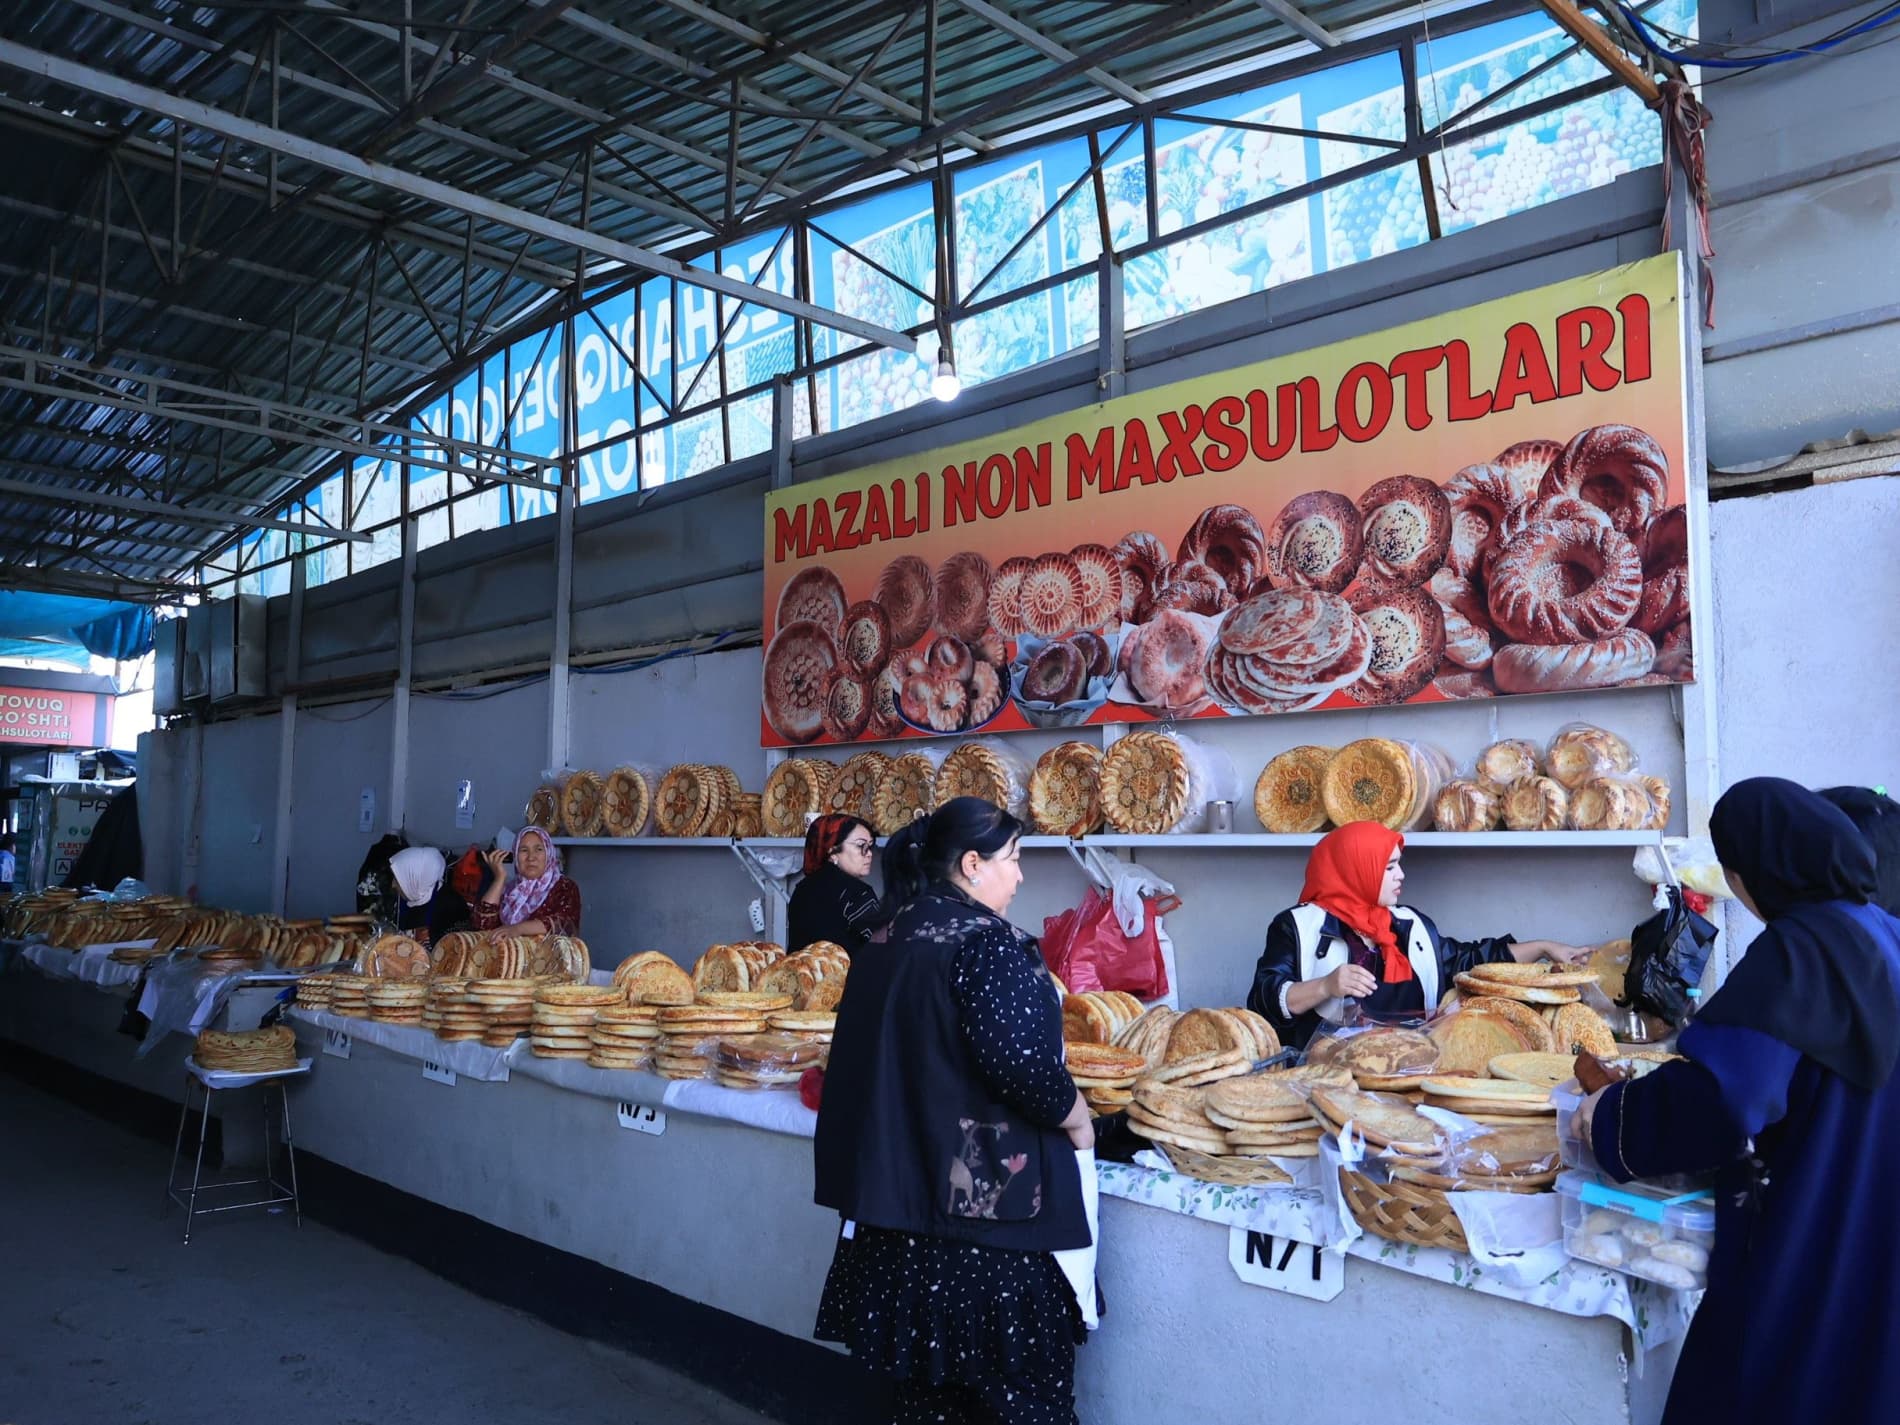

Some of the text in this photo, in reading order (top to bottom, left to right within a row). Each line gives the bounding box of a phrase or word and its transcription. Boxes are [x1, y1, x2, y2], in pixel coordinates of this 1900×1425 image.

[773, 293, 1652, 563] MAZALI NON MAXSULOTLARI
[0, 711, 69, 728] O'SHTI
[0, 727, 72, 740] HSULOTLARI
